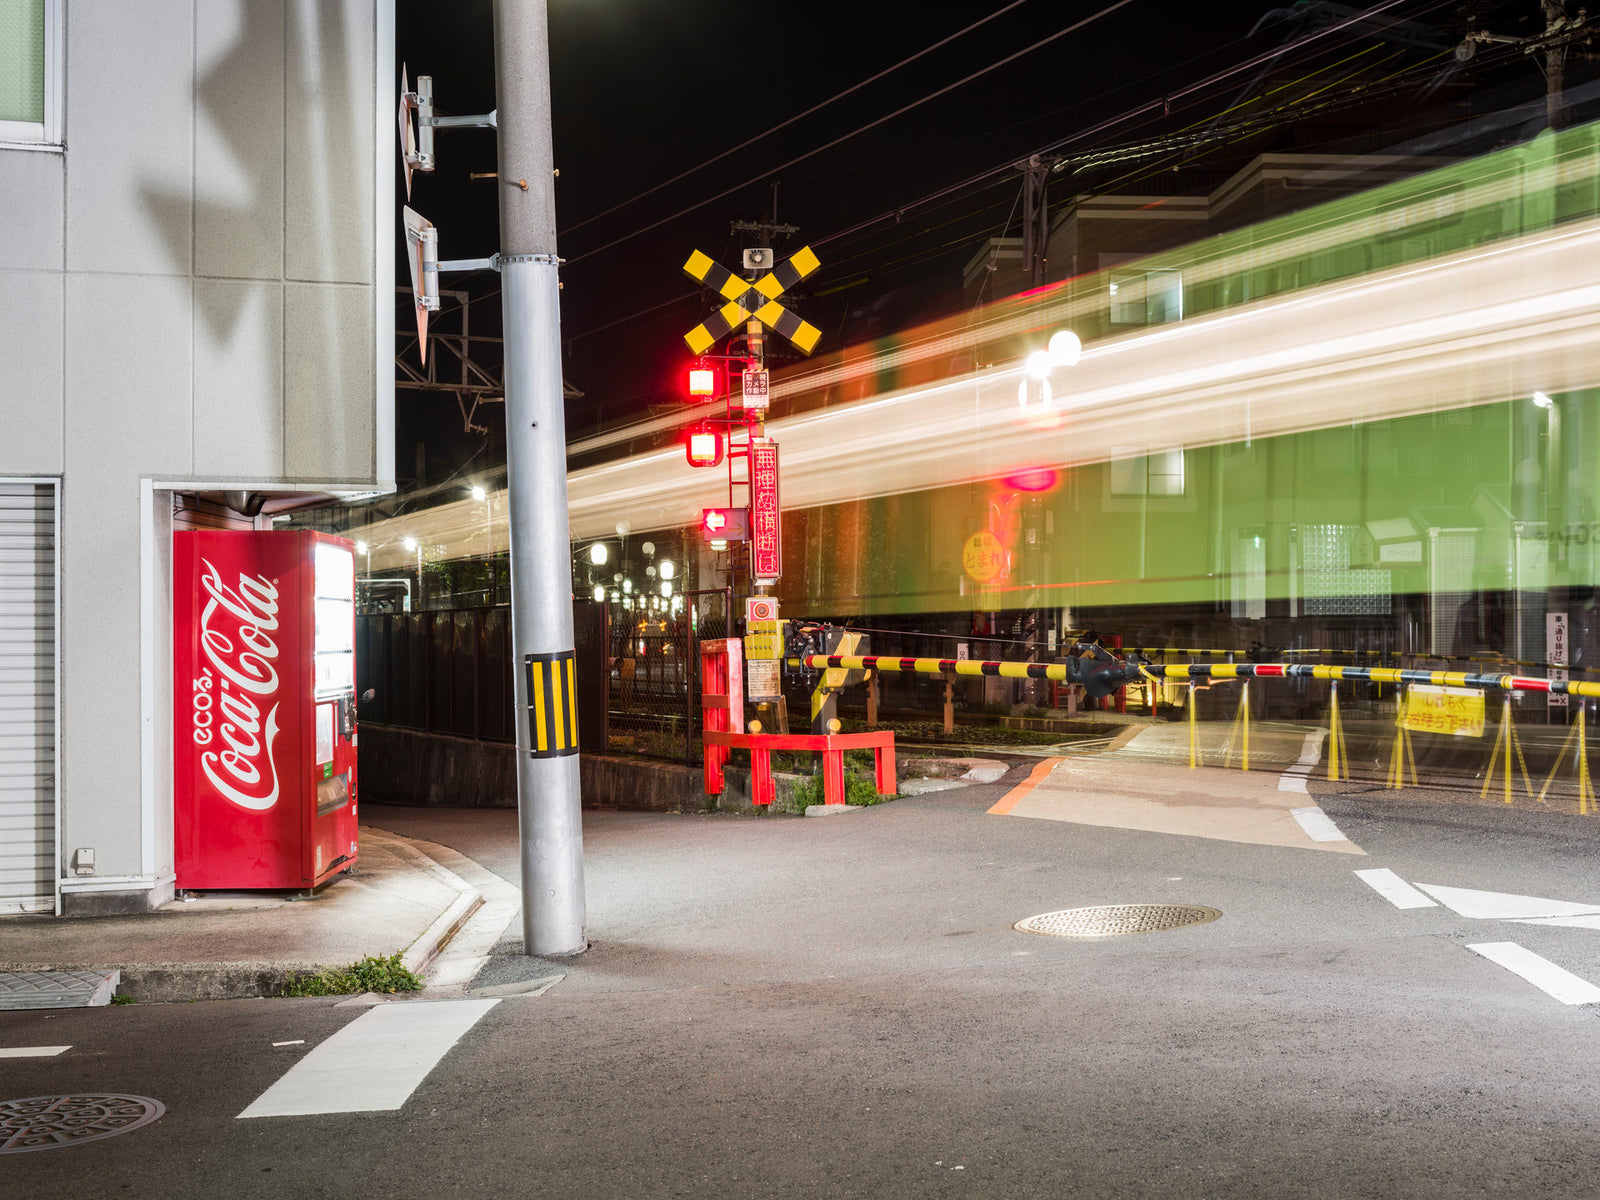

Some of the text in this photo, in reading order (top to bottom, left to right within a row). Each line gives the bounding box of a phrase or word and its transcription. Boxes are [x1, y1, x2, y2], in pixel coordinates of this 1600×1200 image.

[755, 449, 777, 573] 無理な横断は
[965, 550, 1000, 569] とまれ
[201, 557, 280, 810] Coca-Cola
[1425, 694, 1466, 710] しばらく
[1407, 713, 1482, 731] お待ち下さい
